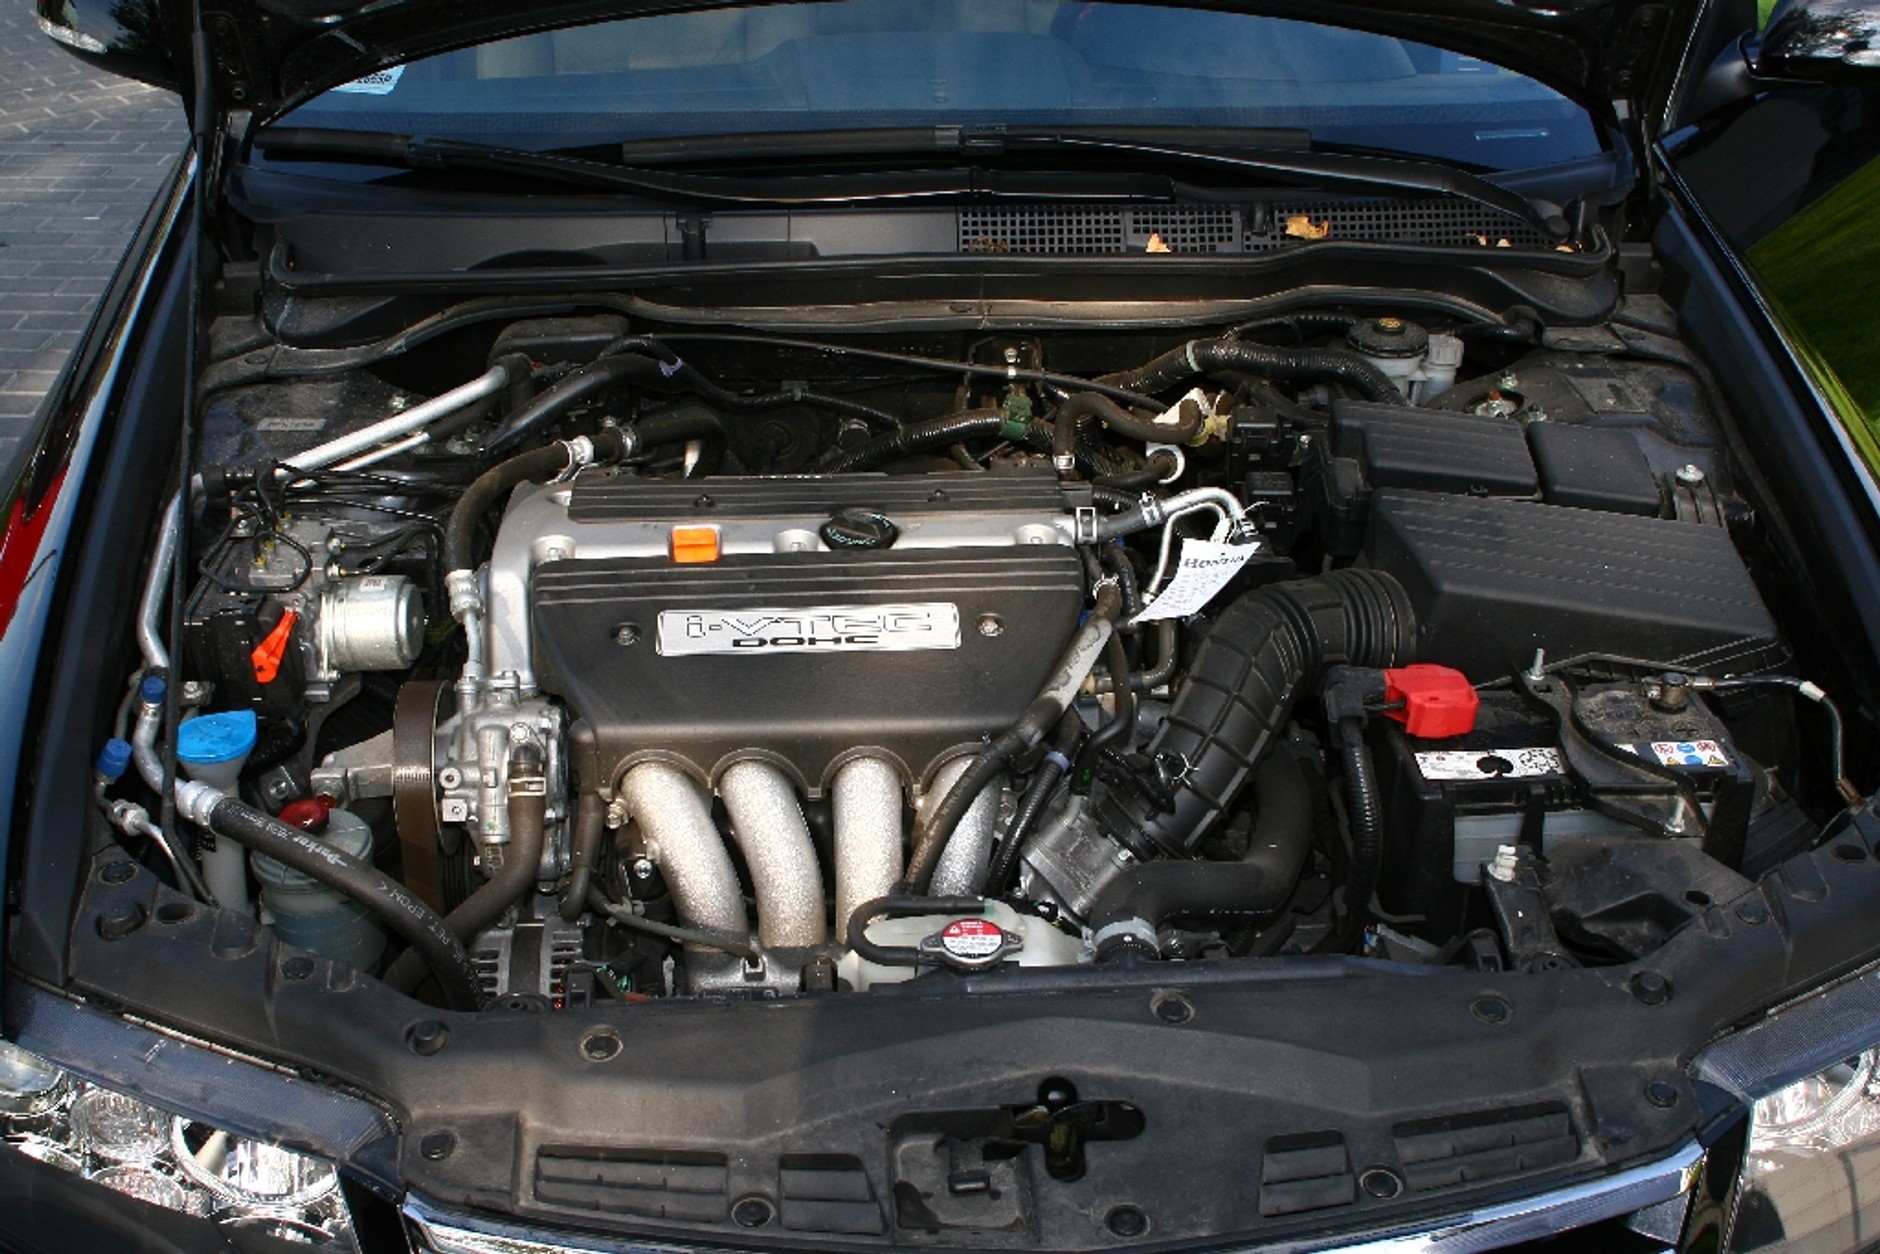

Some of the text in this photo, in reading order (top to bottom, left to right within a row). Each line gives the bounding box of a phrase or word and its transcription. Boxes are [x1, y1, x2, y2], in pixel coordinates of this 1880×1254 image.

[686, 611, 933, 638] i-VTEC
[732, 634, 880, 648] DOHC
[293, 835, 342, 866] Parker
